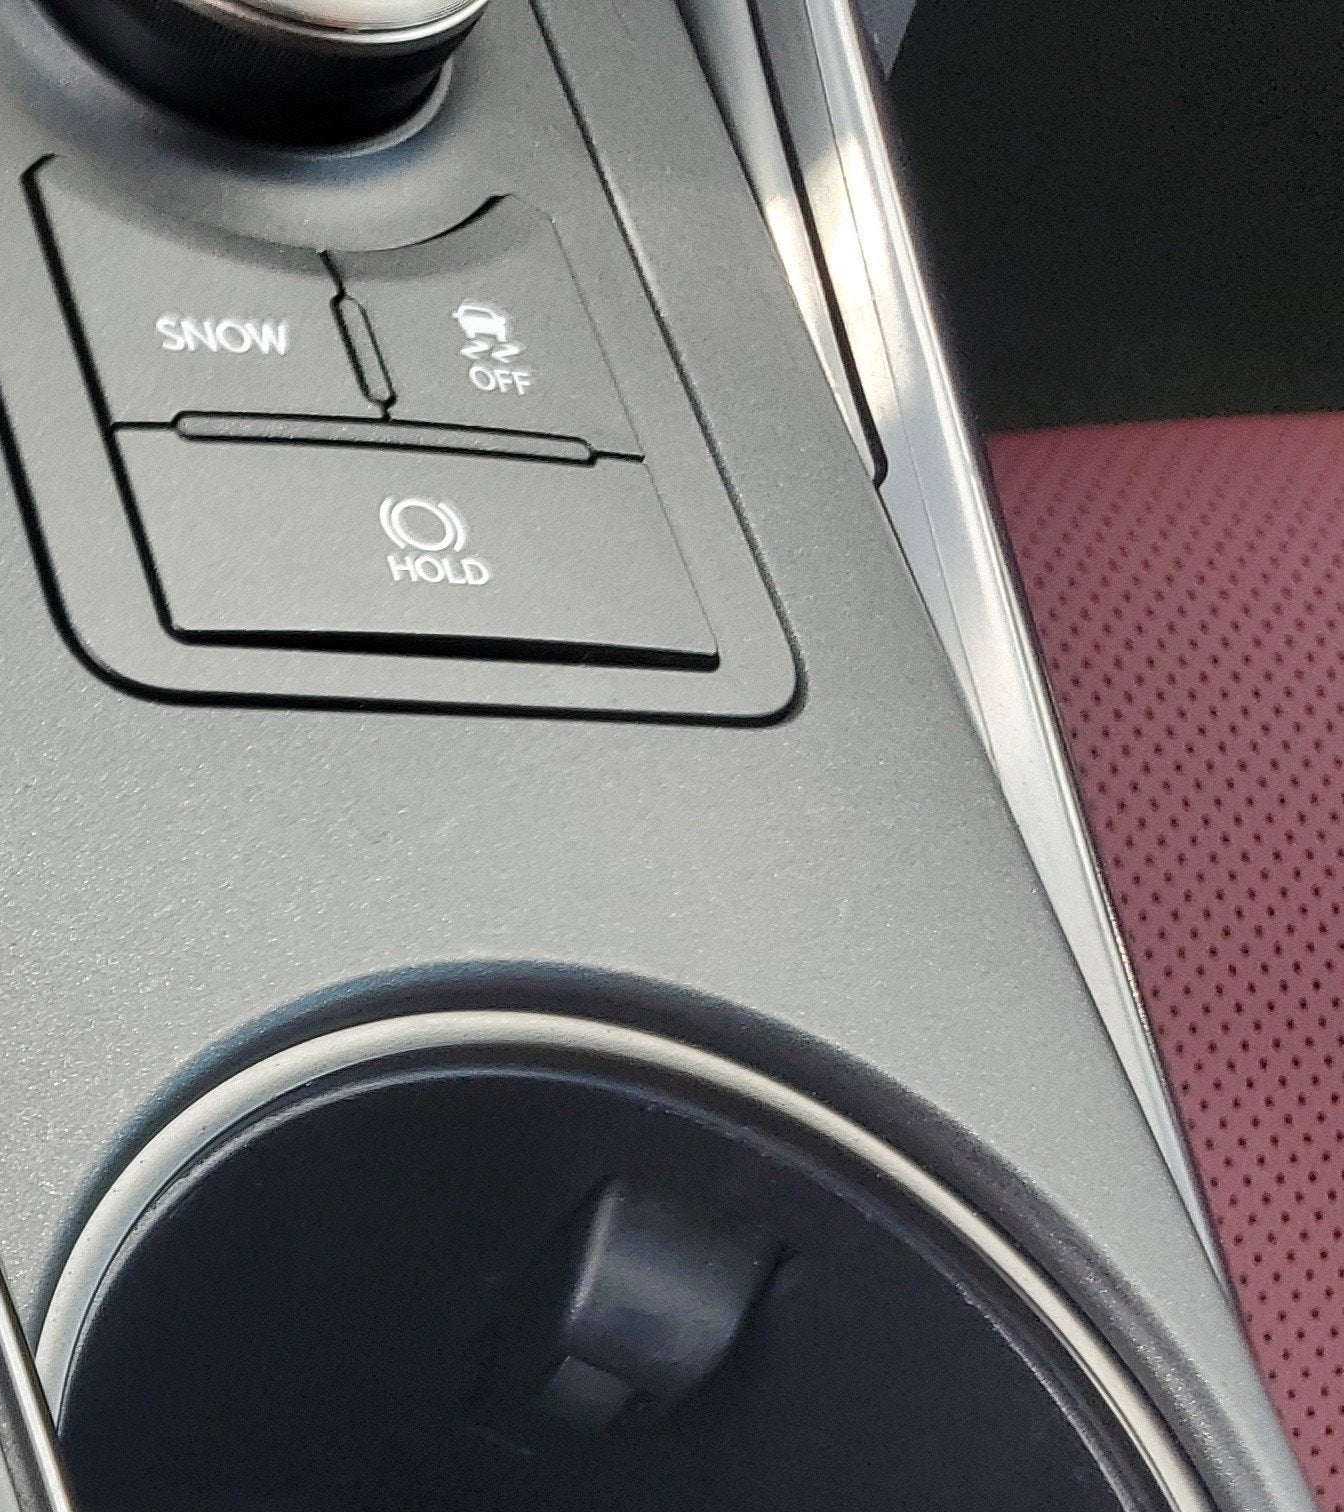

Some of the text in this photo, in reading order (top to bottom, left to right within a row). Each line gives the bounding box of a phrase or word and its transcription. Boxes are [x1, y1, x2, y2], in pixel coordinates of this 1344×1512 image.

[155, 318, 288, 356] SNOW
[468, 366, 531, 393] OFF
[388, 555, 489, 586] HOLD
